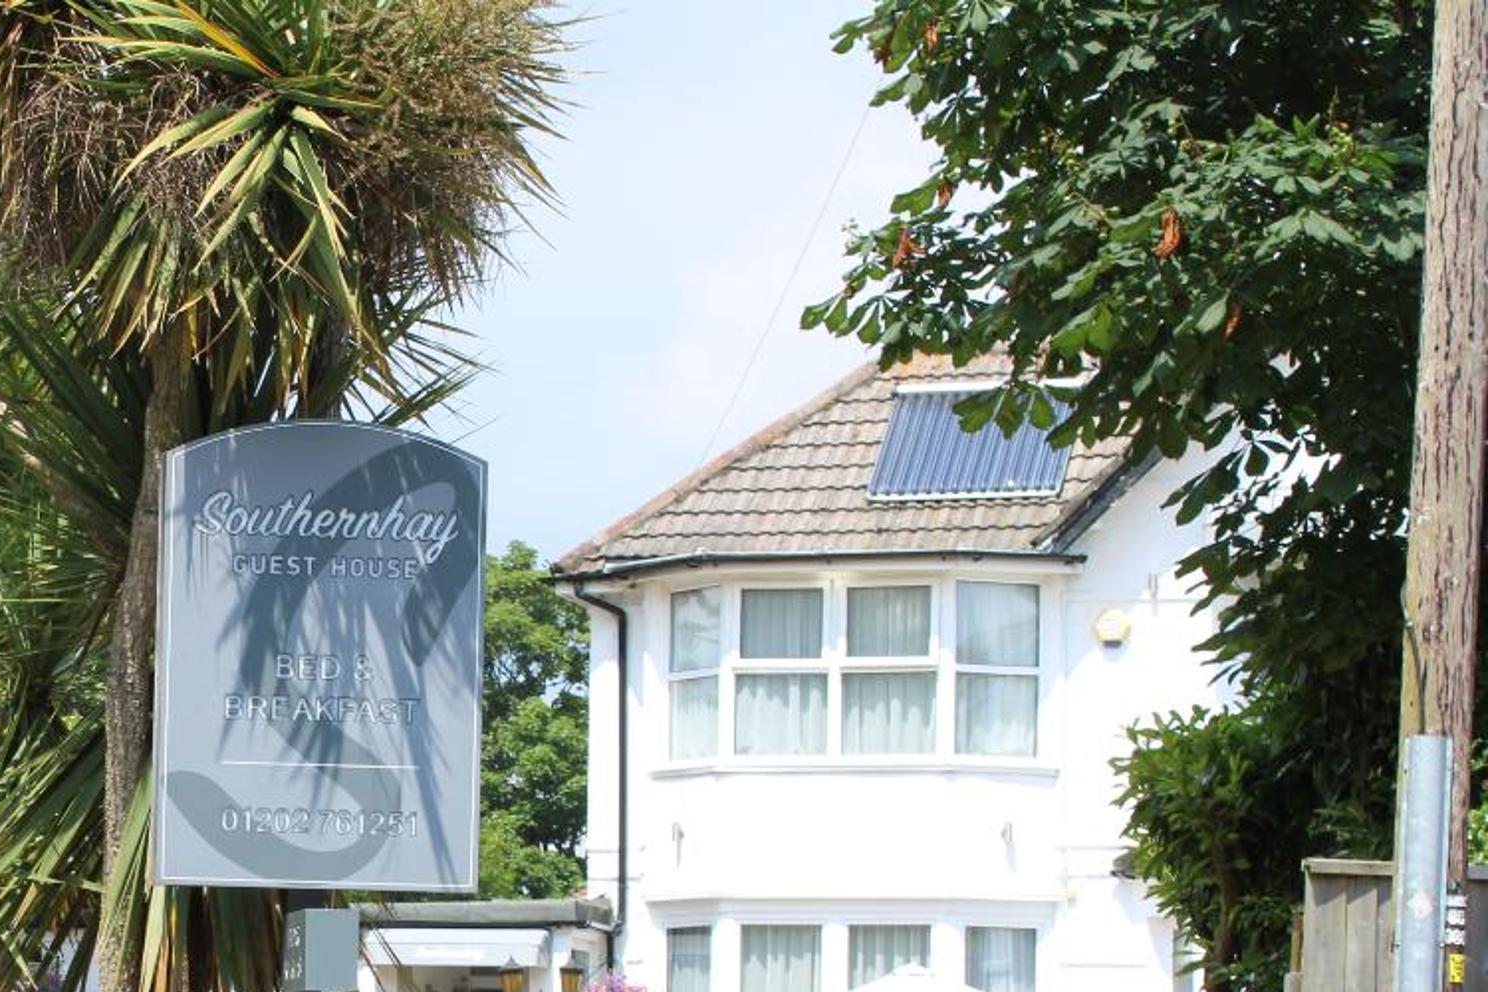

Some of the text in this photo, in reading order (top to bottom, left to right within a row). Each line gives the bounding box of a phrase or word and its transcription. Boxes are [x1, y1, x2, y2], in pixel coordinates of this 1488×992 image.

[194, 491, 459, 565] Southernhay
[233, 555, 418, 579] GUEST HOUSE
[276, 653, 374, 681] BED &
[225, 694, 420, 725] BREAKFAST
[221, 807, 418, 837] 01202 761251
